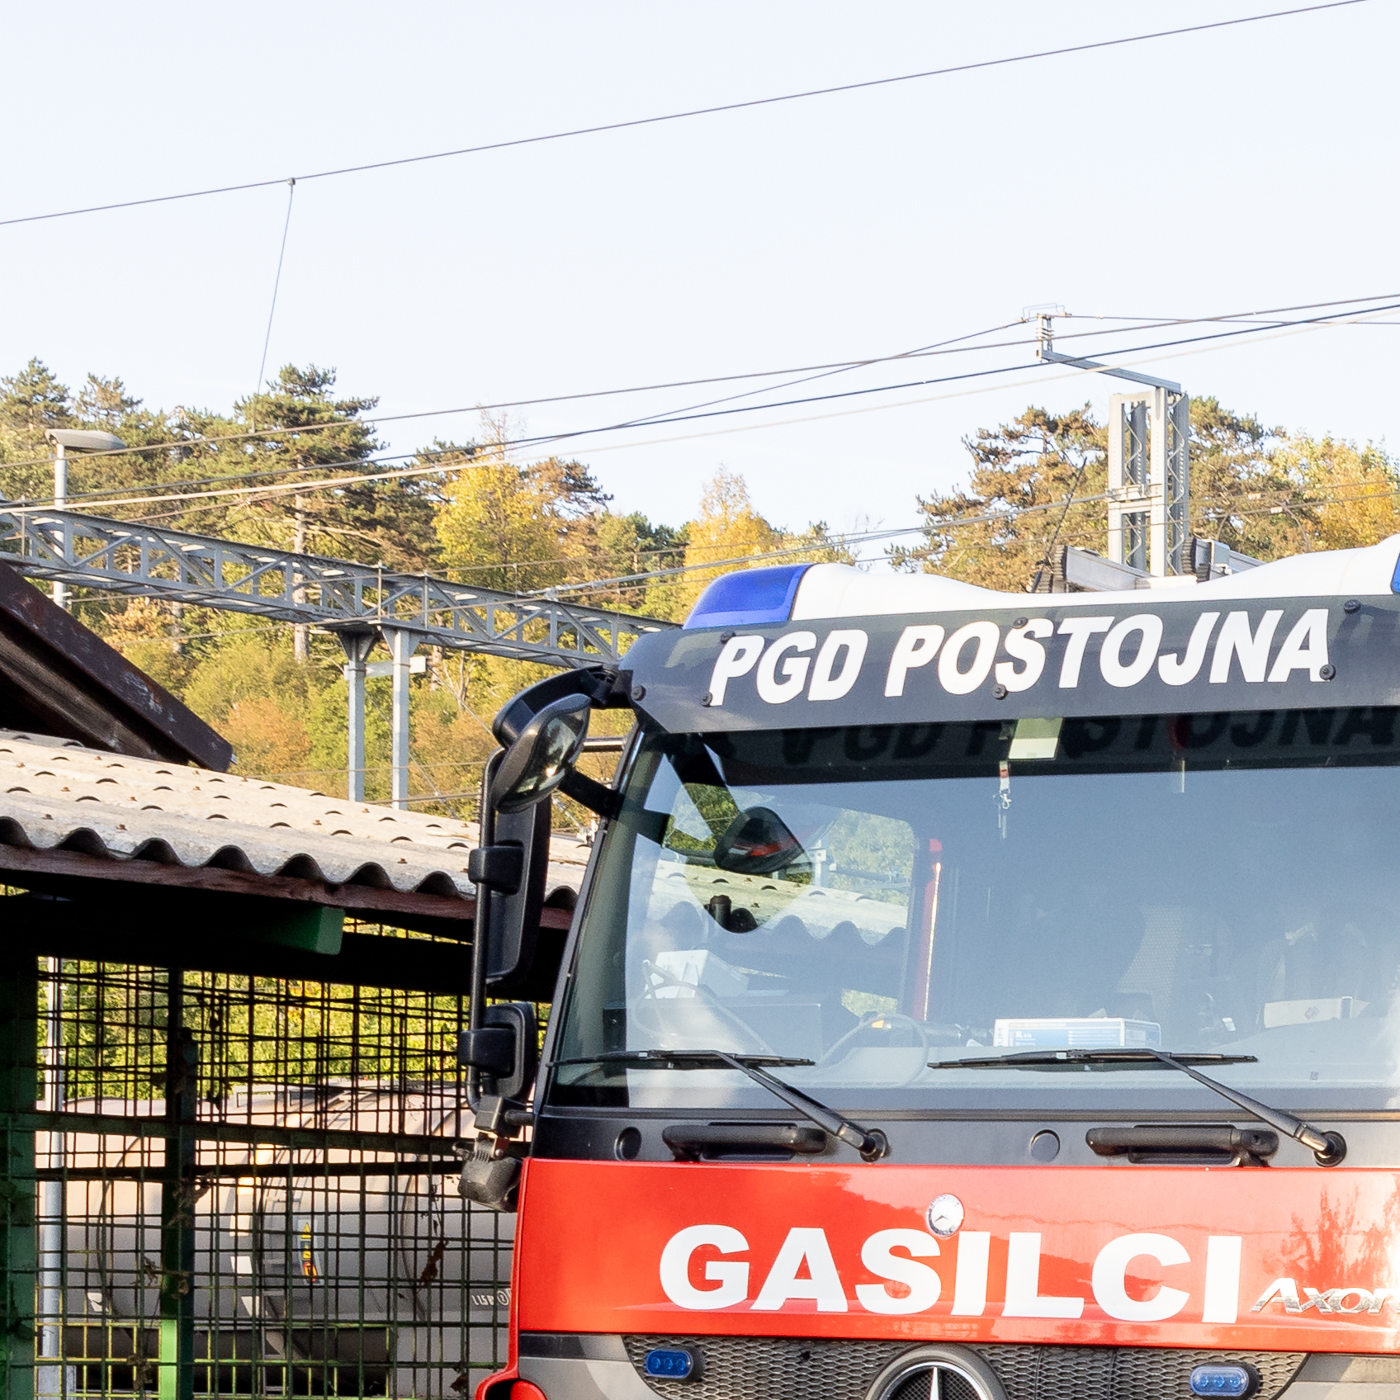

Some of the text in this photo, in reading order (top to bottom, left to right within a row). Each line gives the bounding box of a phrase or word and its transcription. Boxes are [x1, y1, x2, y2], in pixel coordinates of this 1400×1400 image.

[709, 608, 1330, 707] PGD POSTOJNA
[659, 1223, 1243, 1324] GASILCI
